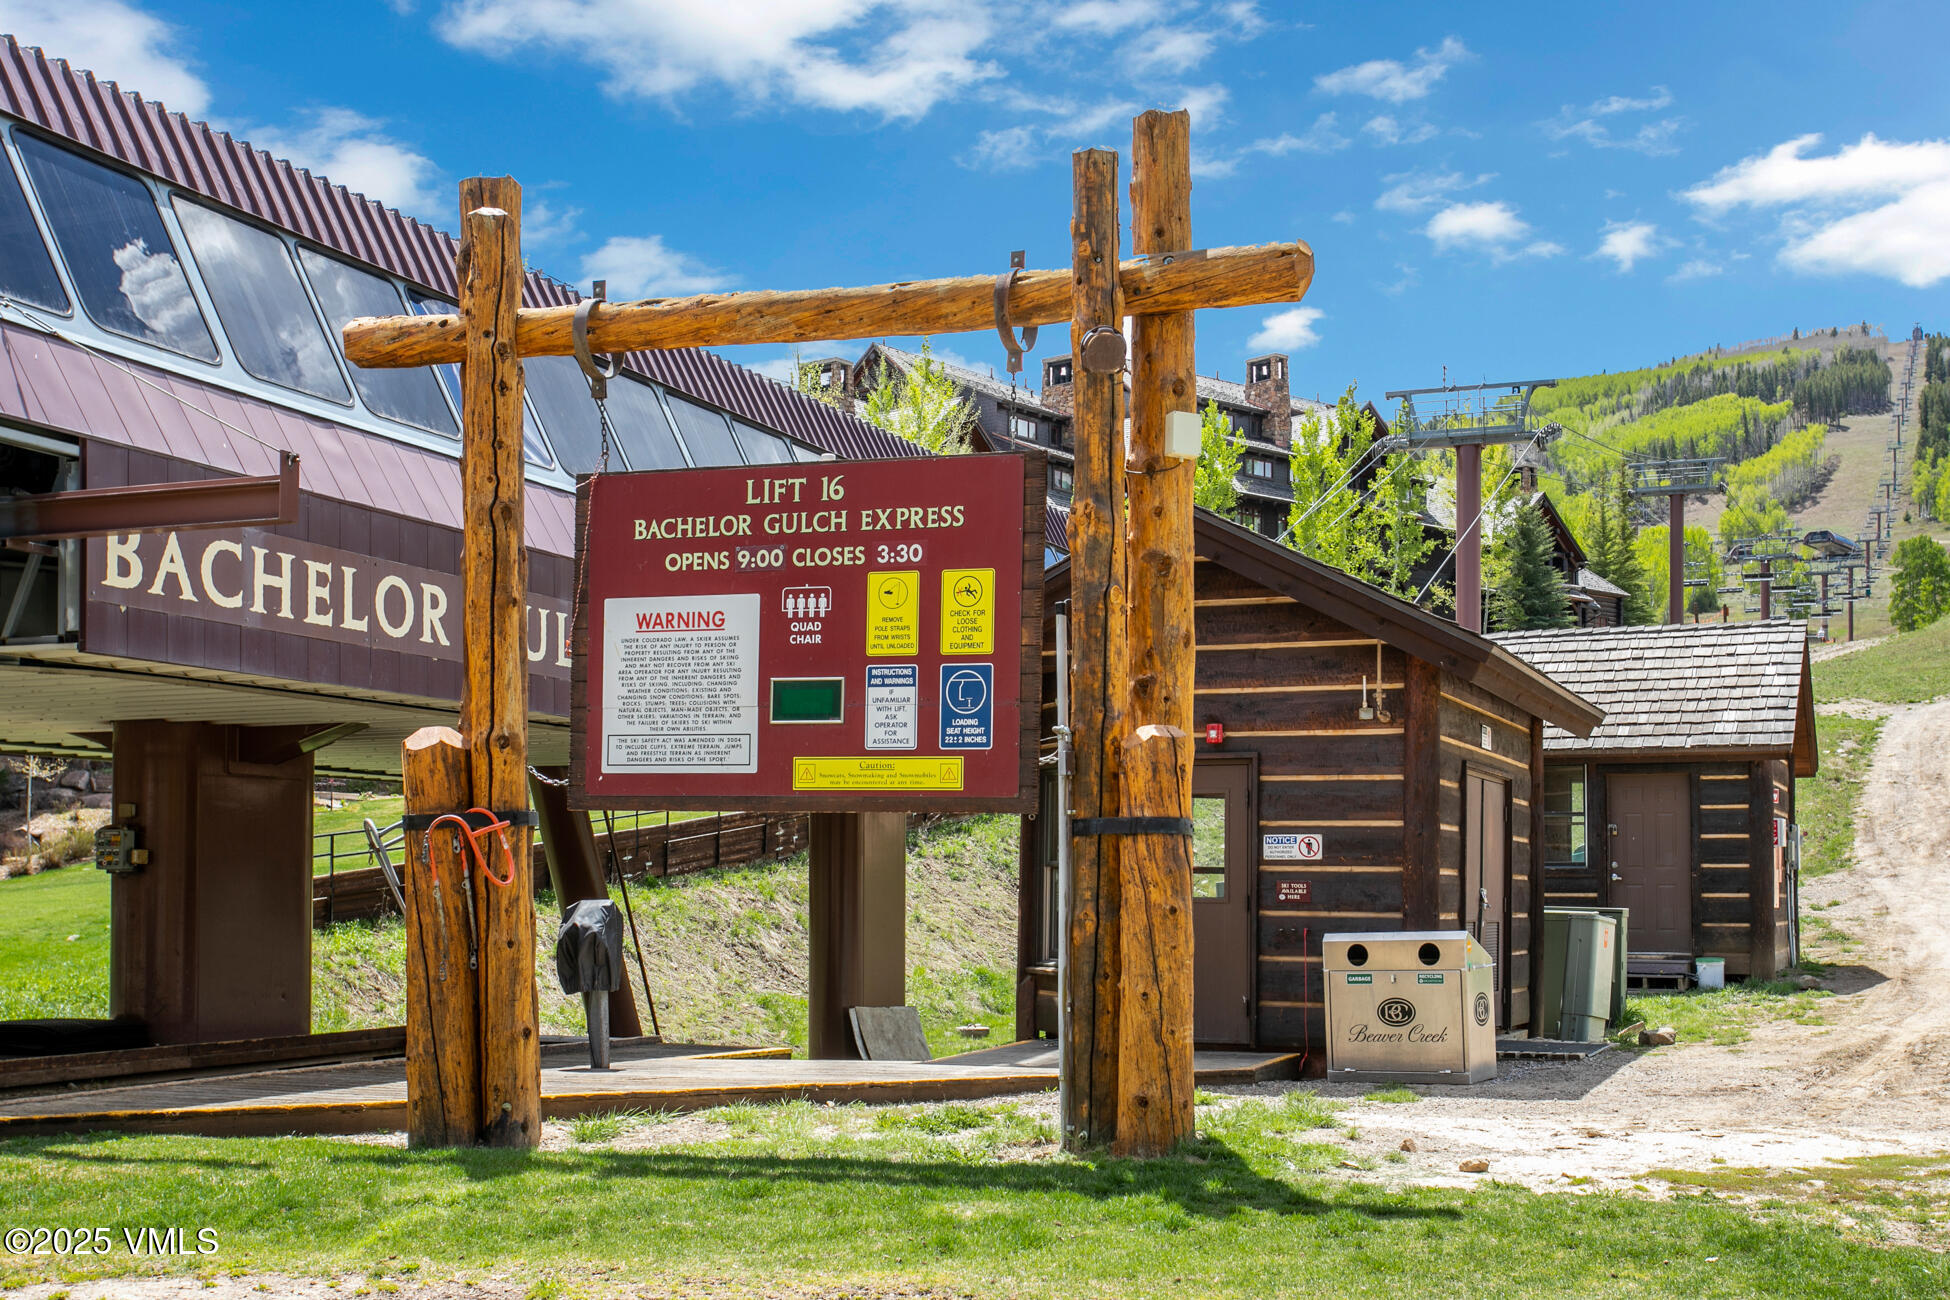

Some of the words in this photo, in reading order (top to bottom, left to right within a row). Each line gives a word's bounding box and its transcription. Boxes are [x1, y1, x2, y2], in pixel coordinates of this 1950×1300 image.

[745, 477, 807, 505] LIFT
[820, 475, 844, 501] 16
[633, 514, 752, 540] BACHELOR
[763, 510, 848, 535] GULCH
[859, 505, 965, 531] EXPRESS
[664, 551, 730, 572] OPENS
[736, 549, 784, 568] 9:00
[792, 546, 866, 566] CLOSES
[876, 544, 923, 564] 3:30
[100, 532, 450, 646] BACHELOR
[636, 610, 726, 630] WARNING
[790, 622, 822, 634] QUAD
[790, 634, 822, 644] CHAIR
[859, 761, 896, 770] Caution:
[1348, 1024, 1404, 1043] Beaver
[1407, 1024, 1448, 1043] Creek
